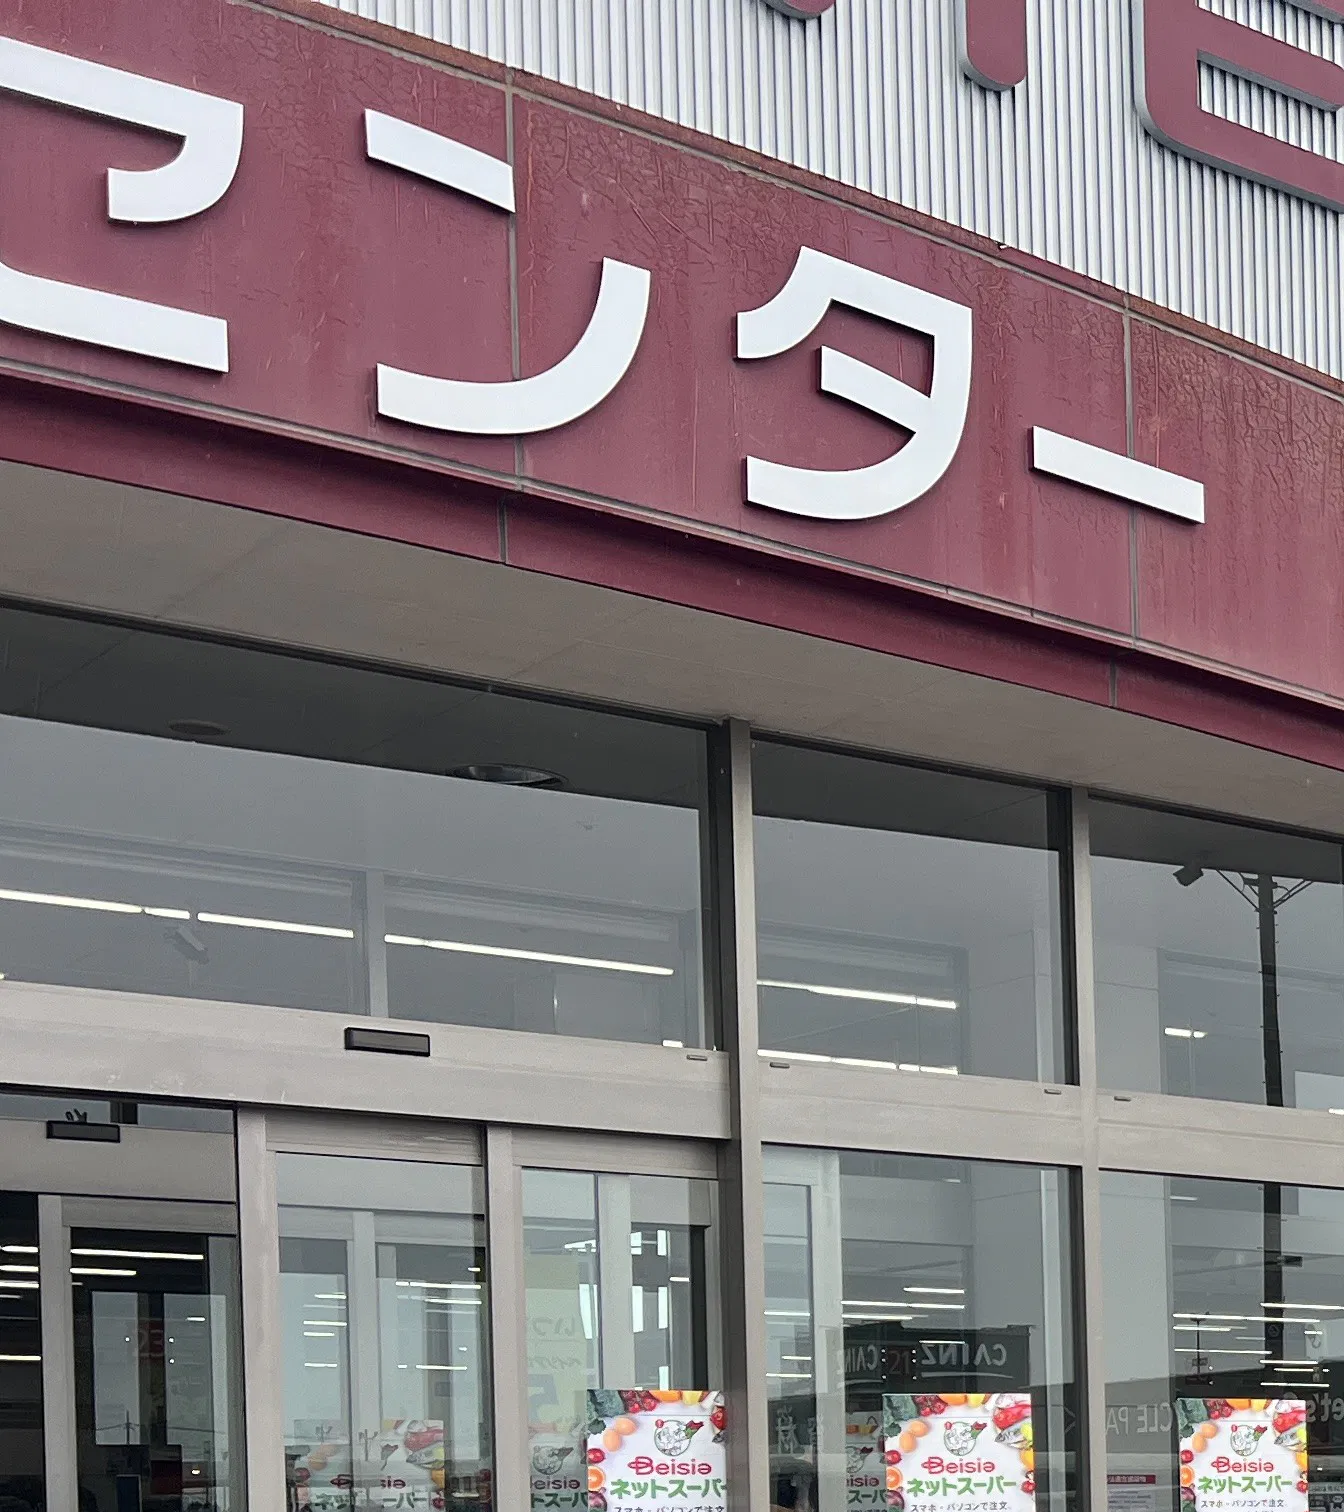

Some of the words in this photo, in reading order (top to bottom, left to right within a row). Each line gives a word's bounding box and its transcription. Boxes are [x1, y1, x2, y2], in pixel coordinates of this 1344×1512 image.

[627, 1455, 712, 1476] Beisia
[921, 1456, 996, 1475] Beisia
[1210, 1456, 1274, 1474] Beisia
[906, 1475, 1017, 1497] ネットスーパー
[1197, 1475, 1293, 1494] ネットスーパー
